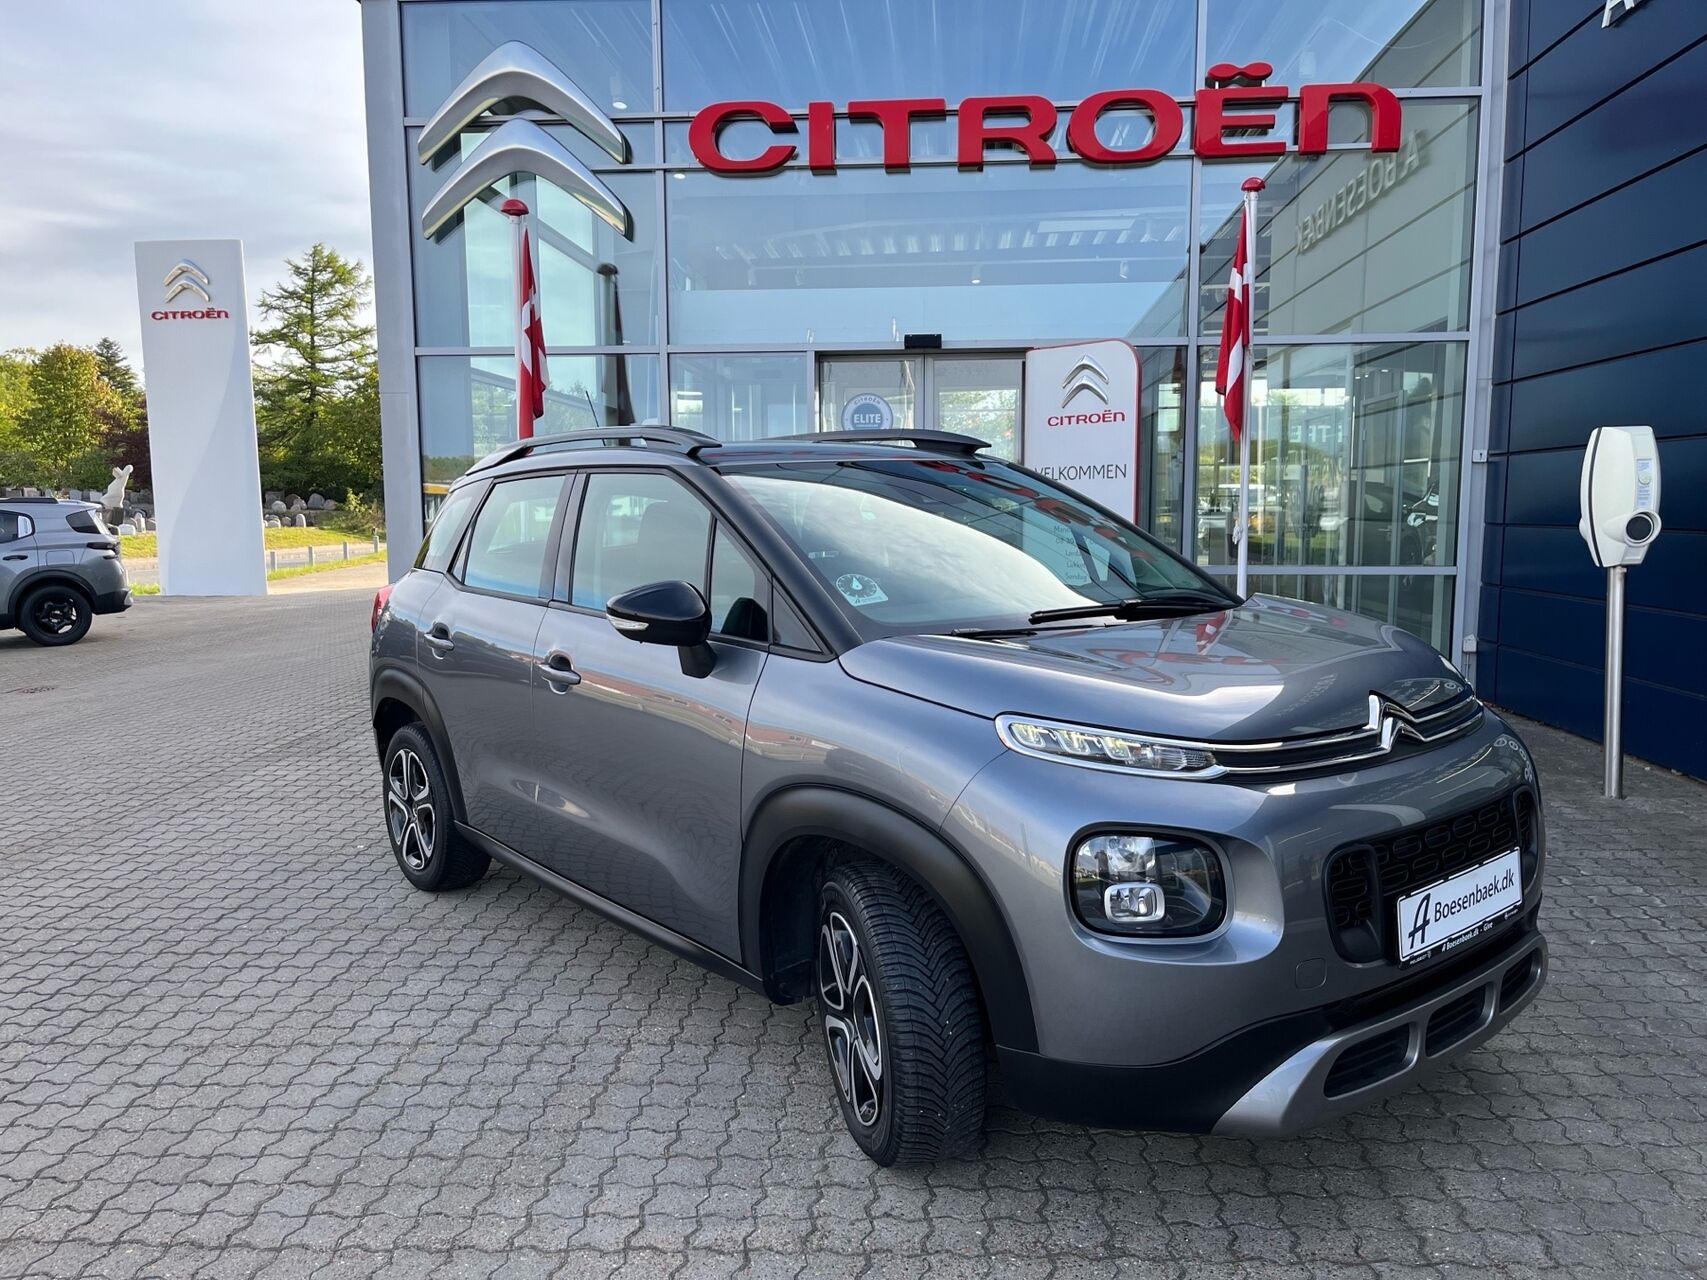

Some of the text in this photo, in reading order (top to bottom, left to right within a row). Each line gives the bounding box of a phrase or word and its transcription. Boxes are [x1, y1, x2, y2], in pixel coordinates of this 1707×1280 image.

[688, 62, 1402, 174] CITROËN
[151, 307, 229, 321] CITROËN
[853, 413, 881, 424] ELITE
[1047, 409, 1126, 427] CITROËN
[1034, 463, 1127, 481] VELKOMMEN
[1408, 868, 1515, 950] A Boesenbaek.dk
